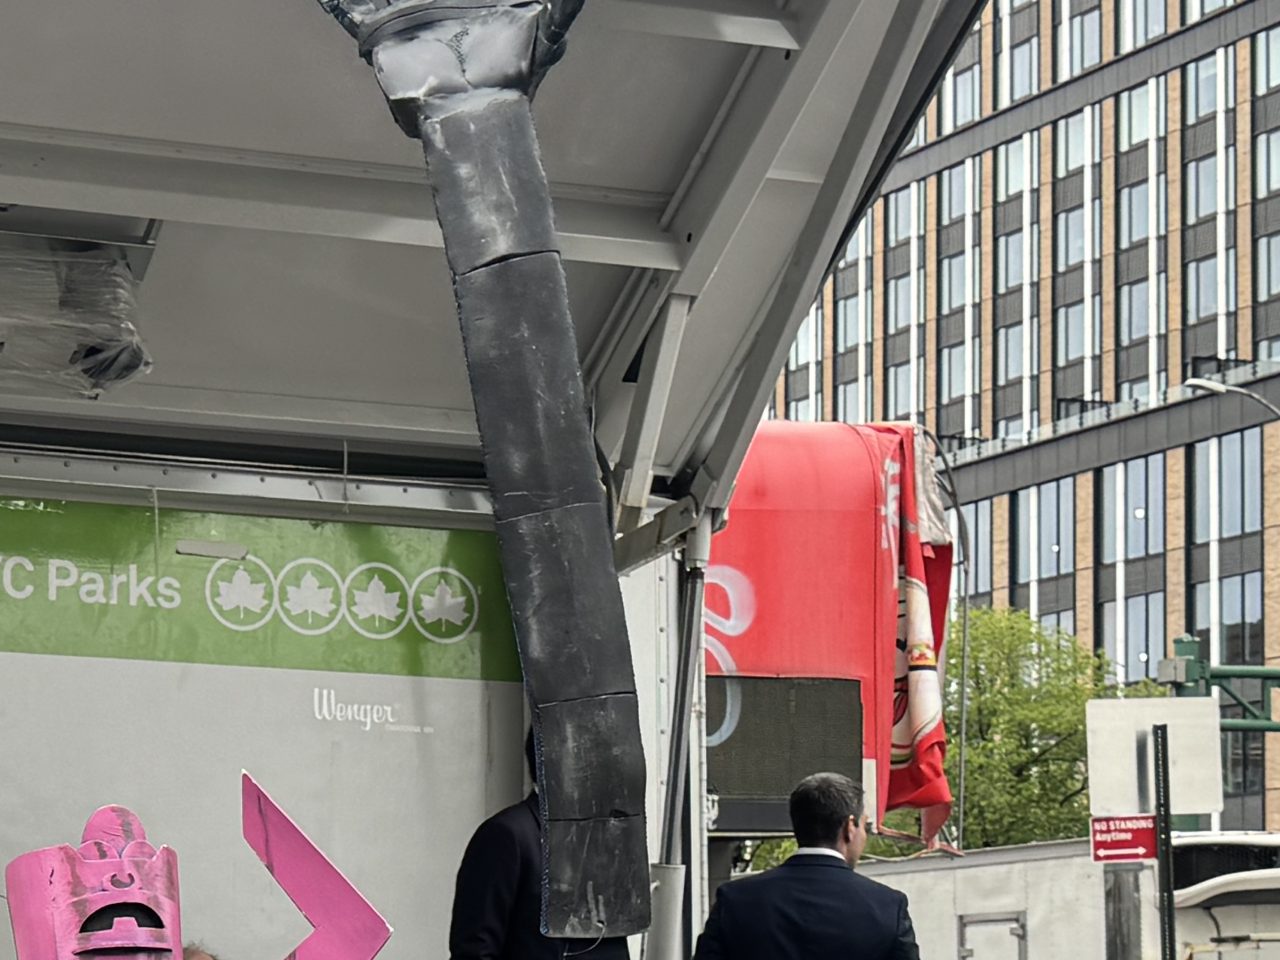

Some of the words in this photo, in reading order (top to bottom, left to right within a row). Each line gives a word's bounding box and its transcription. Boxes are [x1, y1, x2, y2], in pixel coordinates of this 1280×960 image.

[47, 558, 182, 609] Parks
[313, 687, 396, 731] Wenger
[1093, 821, 1107, 830] NO
[1108, 819, 1154, 830] STANDING
[1095, 832, 1132, 842] Anytime
